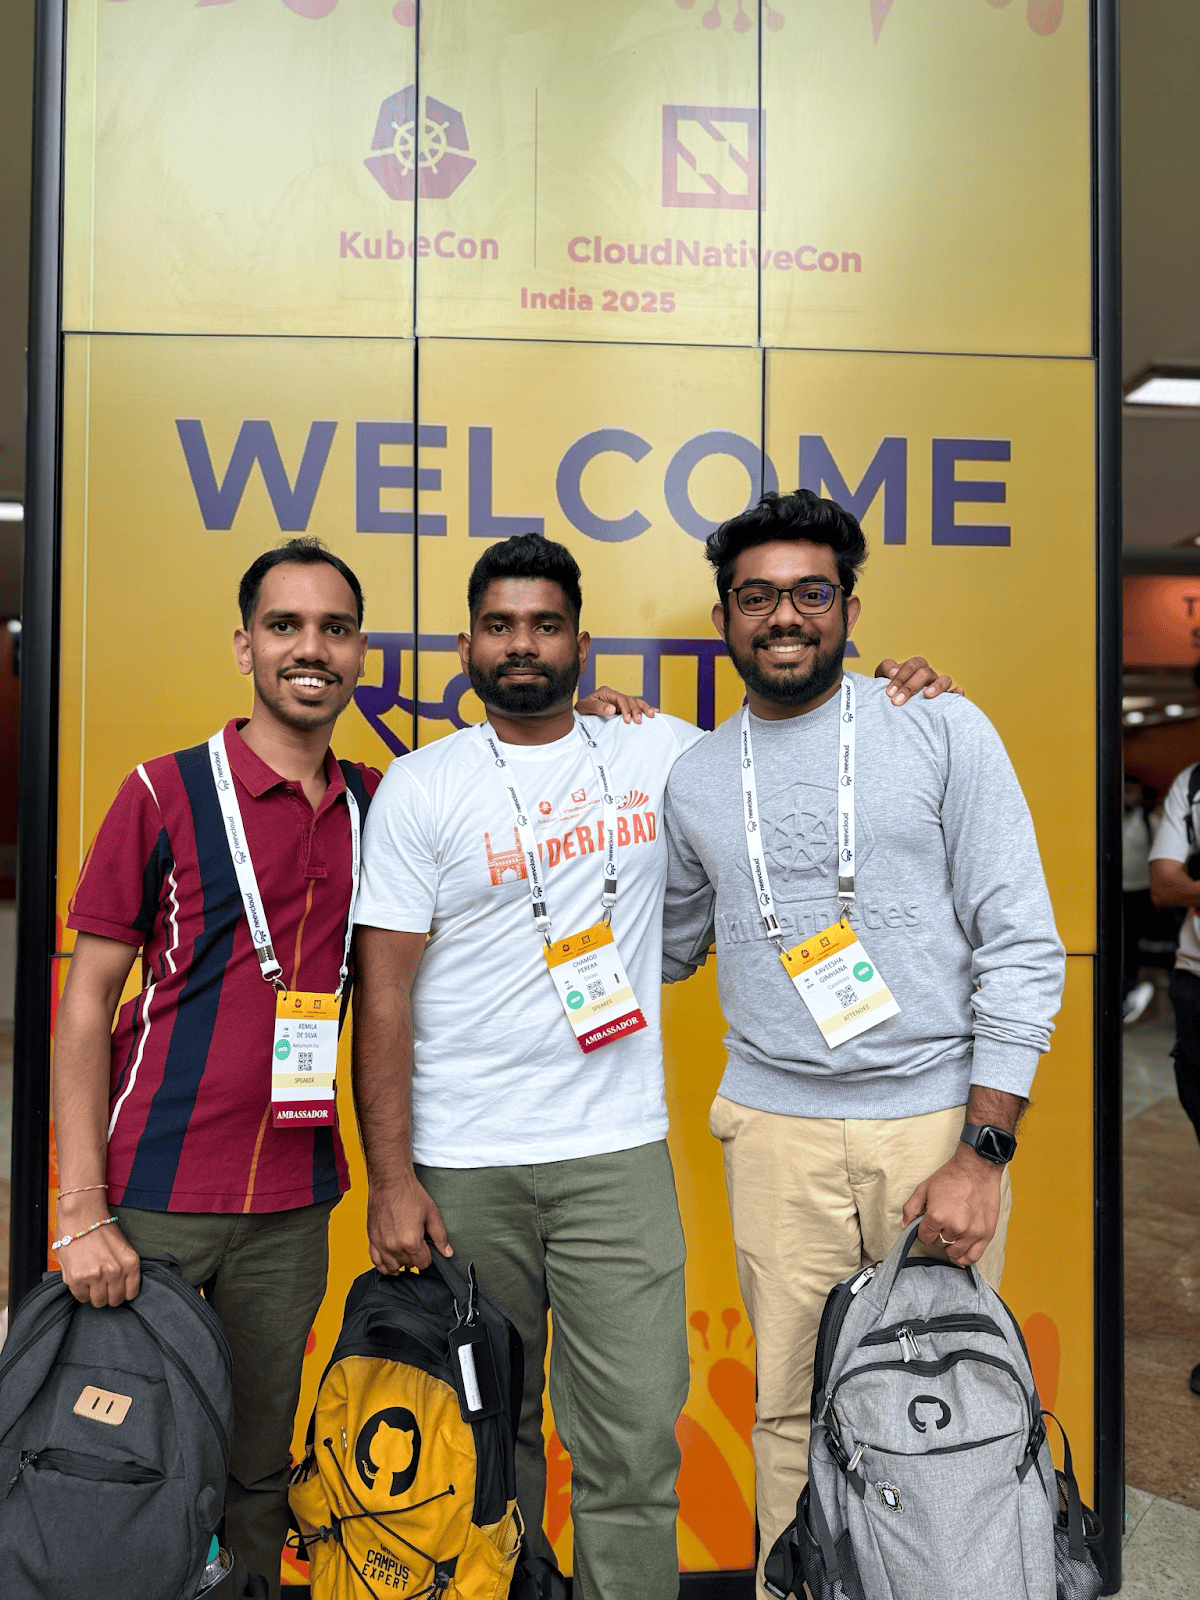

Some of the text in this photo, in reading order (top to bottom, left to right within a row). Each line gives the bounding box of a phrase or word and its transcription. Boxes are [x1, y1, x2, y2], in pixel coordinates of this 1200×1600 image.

[338, 230, 500, 260] KubeCon
[566, 236, 863, 273] CloudNativeCon
[519, 286, 677, 314] India 2025
[174, 418, 1013, 548] WELCOME
[527, 851, 539, 884] neevcloud
[752, 857, 765, 891] neevcloud
[245, 892, 261, 928] neevcloud
[814, 956, 844, 977] KAVEESHA
[843, 1003, 871, 1022] ATTENDEE
[584, 1016, 639, 1046] AMBASSADOR
[276, 1109, 328, 1120] AMBASSADOR
[361, 1563, 408, 1591] EXPERT
[366, 1549, 410, 1580] CAMPUS
